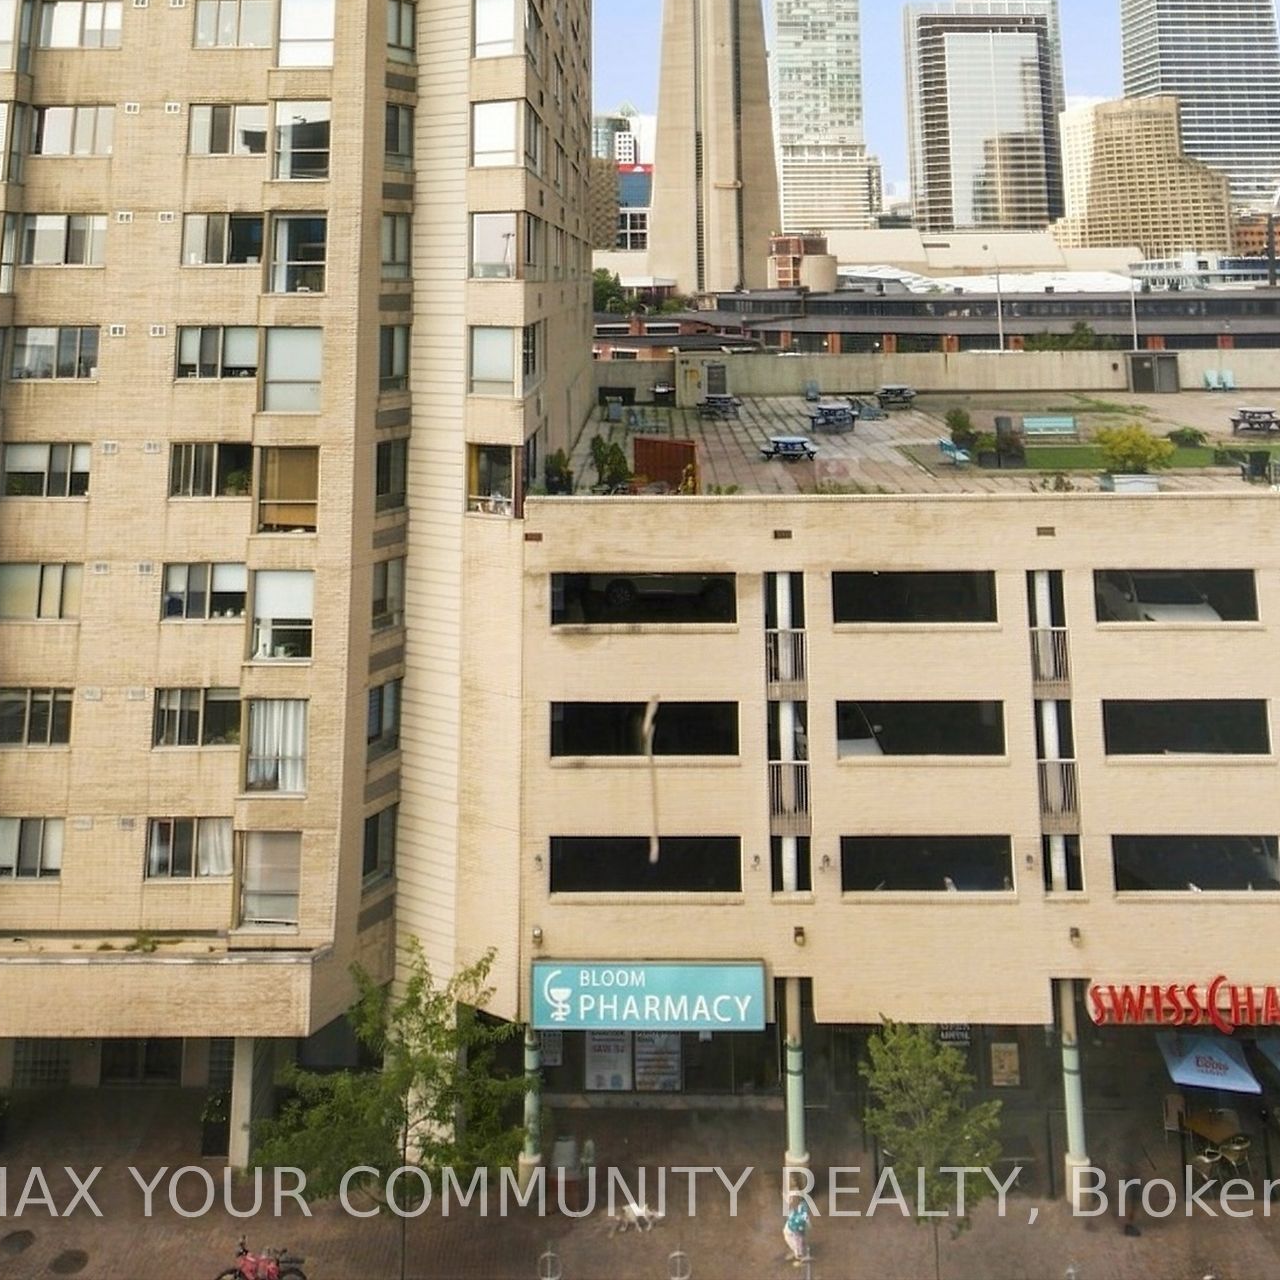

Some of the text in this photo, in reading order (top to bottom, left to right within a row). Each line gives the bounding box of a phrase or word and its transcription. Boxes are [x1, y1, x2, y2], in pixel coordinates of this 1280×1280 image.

[580, 970, 646, 987] BLOOM
[580, 994, 752, 1022] PHARMACY
[1089, 984, 1203, 1026] SWISS
